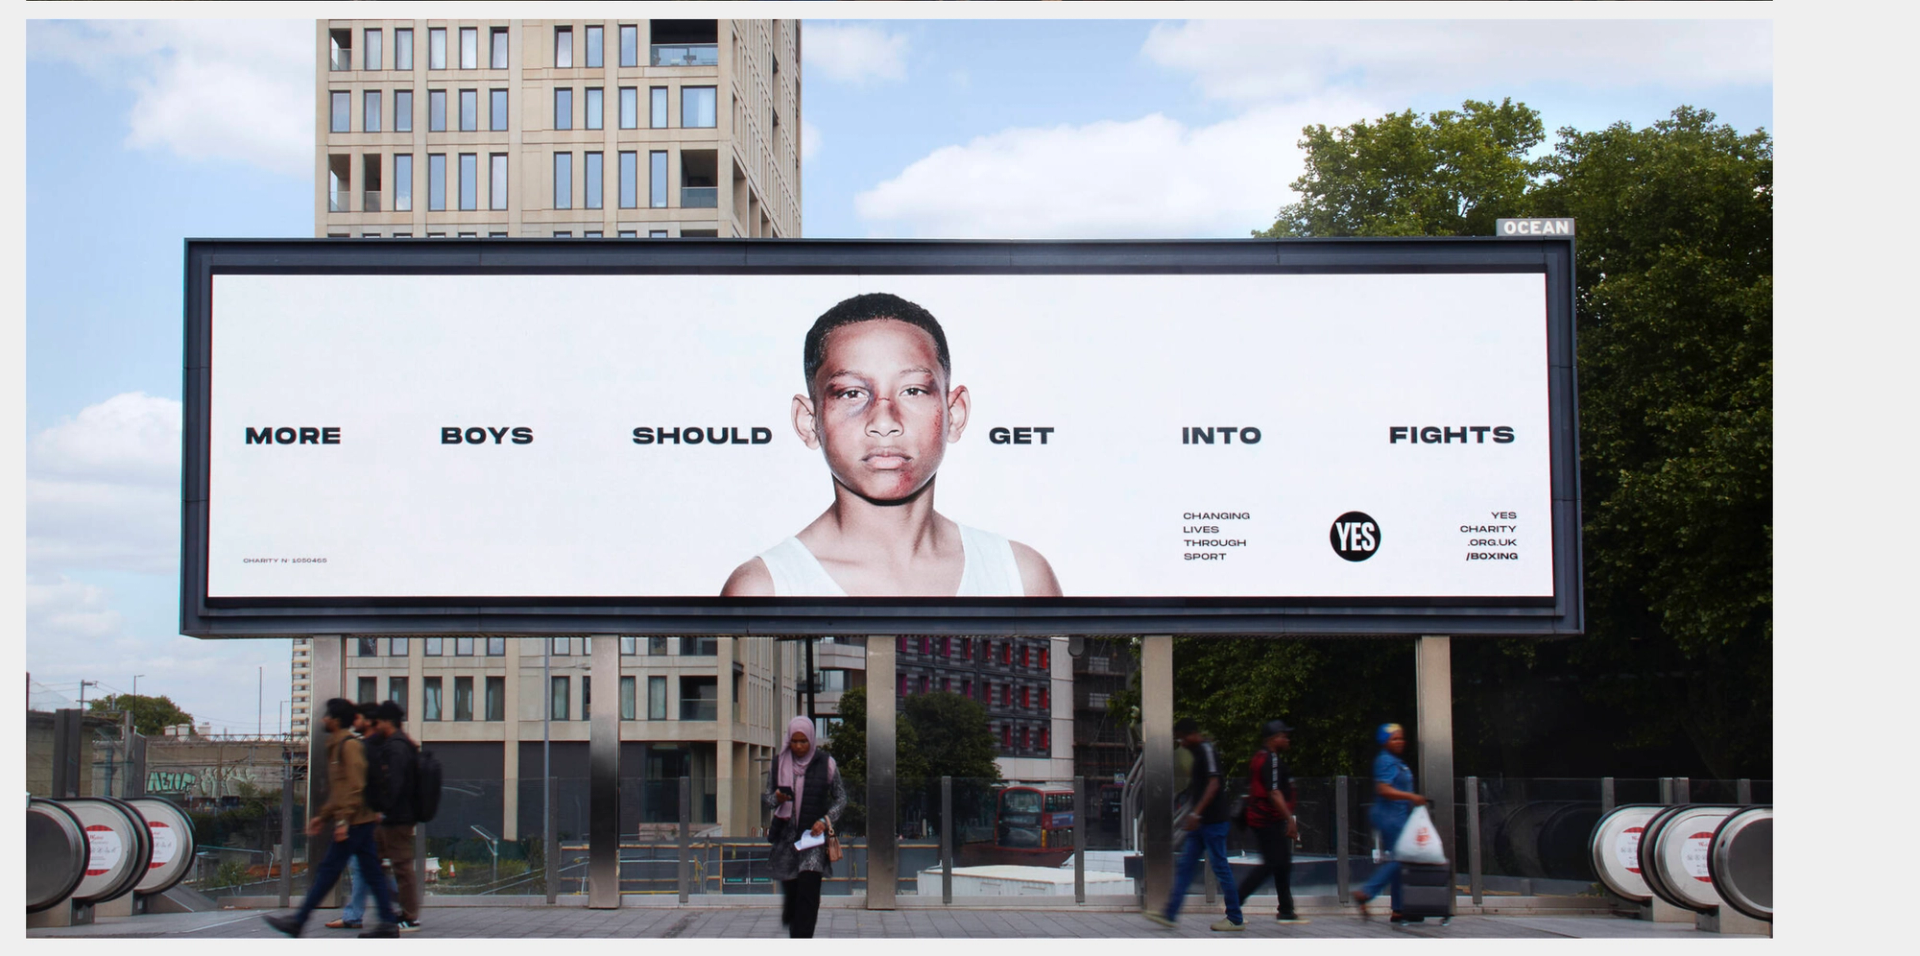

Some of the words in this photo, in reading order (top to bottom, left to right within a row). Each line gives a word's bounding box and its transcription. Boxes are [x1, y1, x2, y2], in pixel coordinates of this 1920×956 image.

[1503, 220, 1569, 234] OCEAN
[245, 426, 341, 445] MORE
[441, 426, 534, 445] BOYS
[632, 426, 773, 445] SHOULD
[988, 426, 1055, 445] GET
[1182, 426, 1262, 445] INTO
[1389, 425, 1515, 445] FIGHTS
[1183, 512, 1251, 520] CHANGING
[1491, 511, 1518, 520] YES
[1183, 525, 1220, 534] LIVES
[1459, 525, 1517, 533] CHARITY
[1335, 521, 1376, 551] YES
[1183, 539, 1247, 547] THROUGH
[1467, 538, 1517, 547] .ORG.UK
[1183, 552, 1227, 561] SPORT
[1466, 552, 1519, 562] /BOXING
